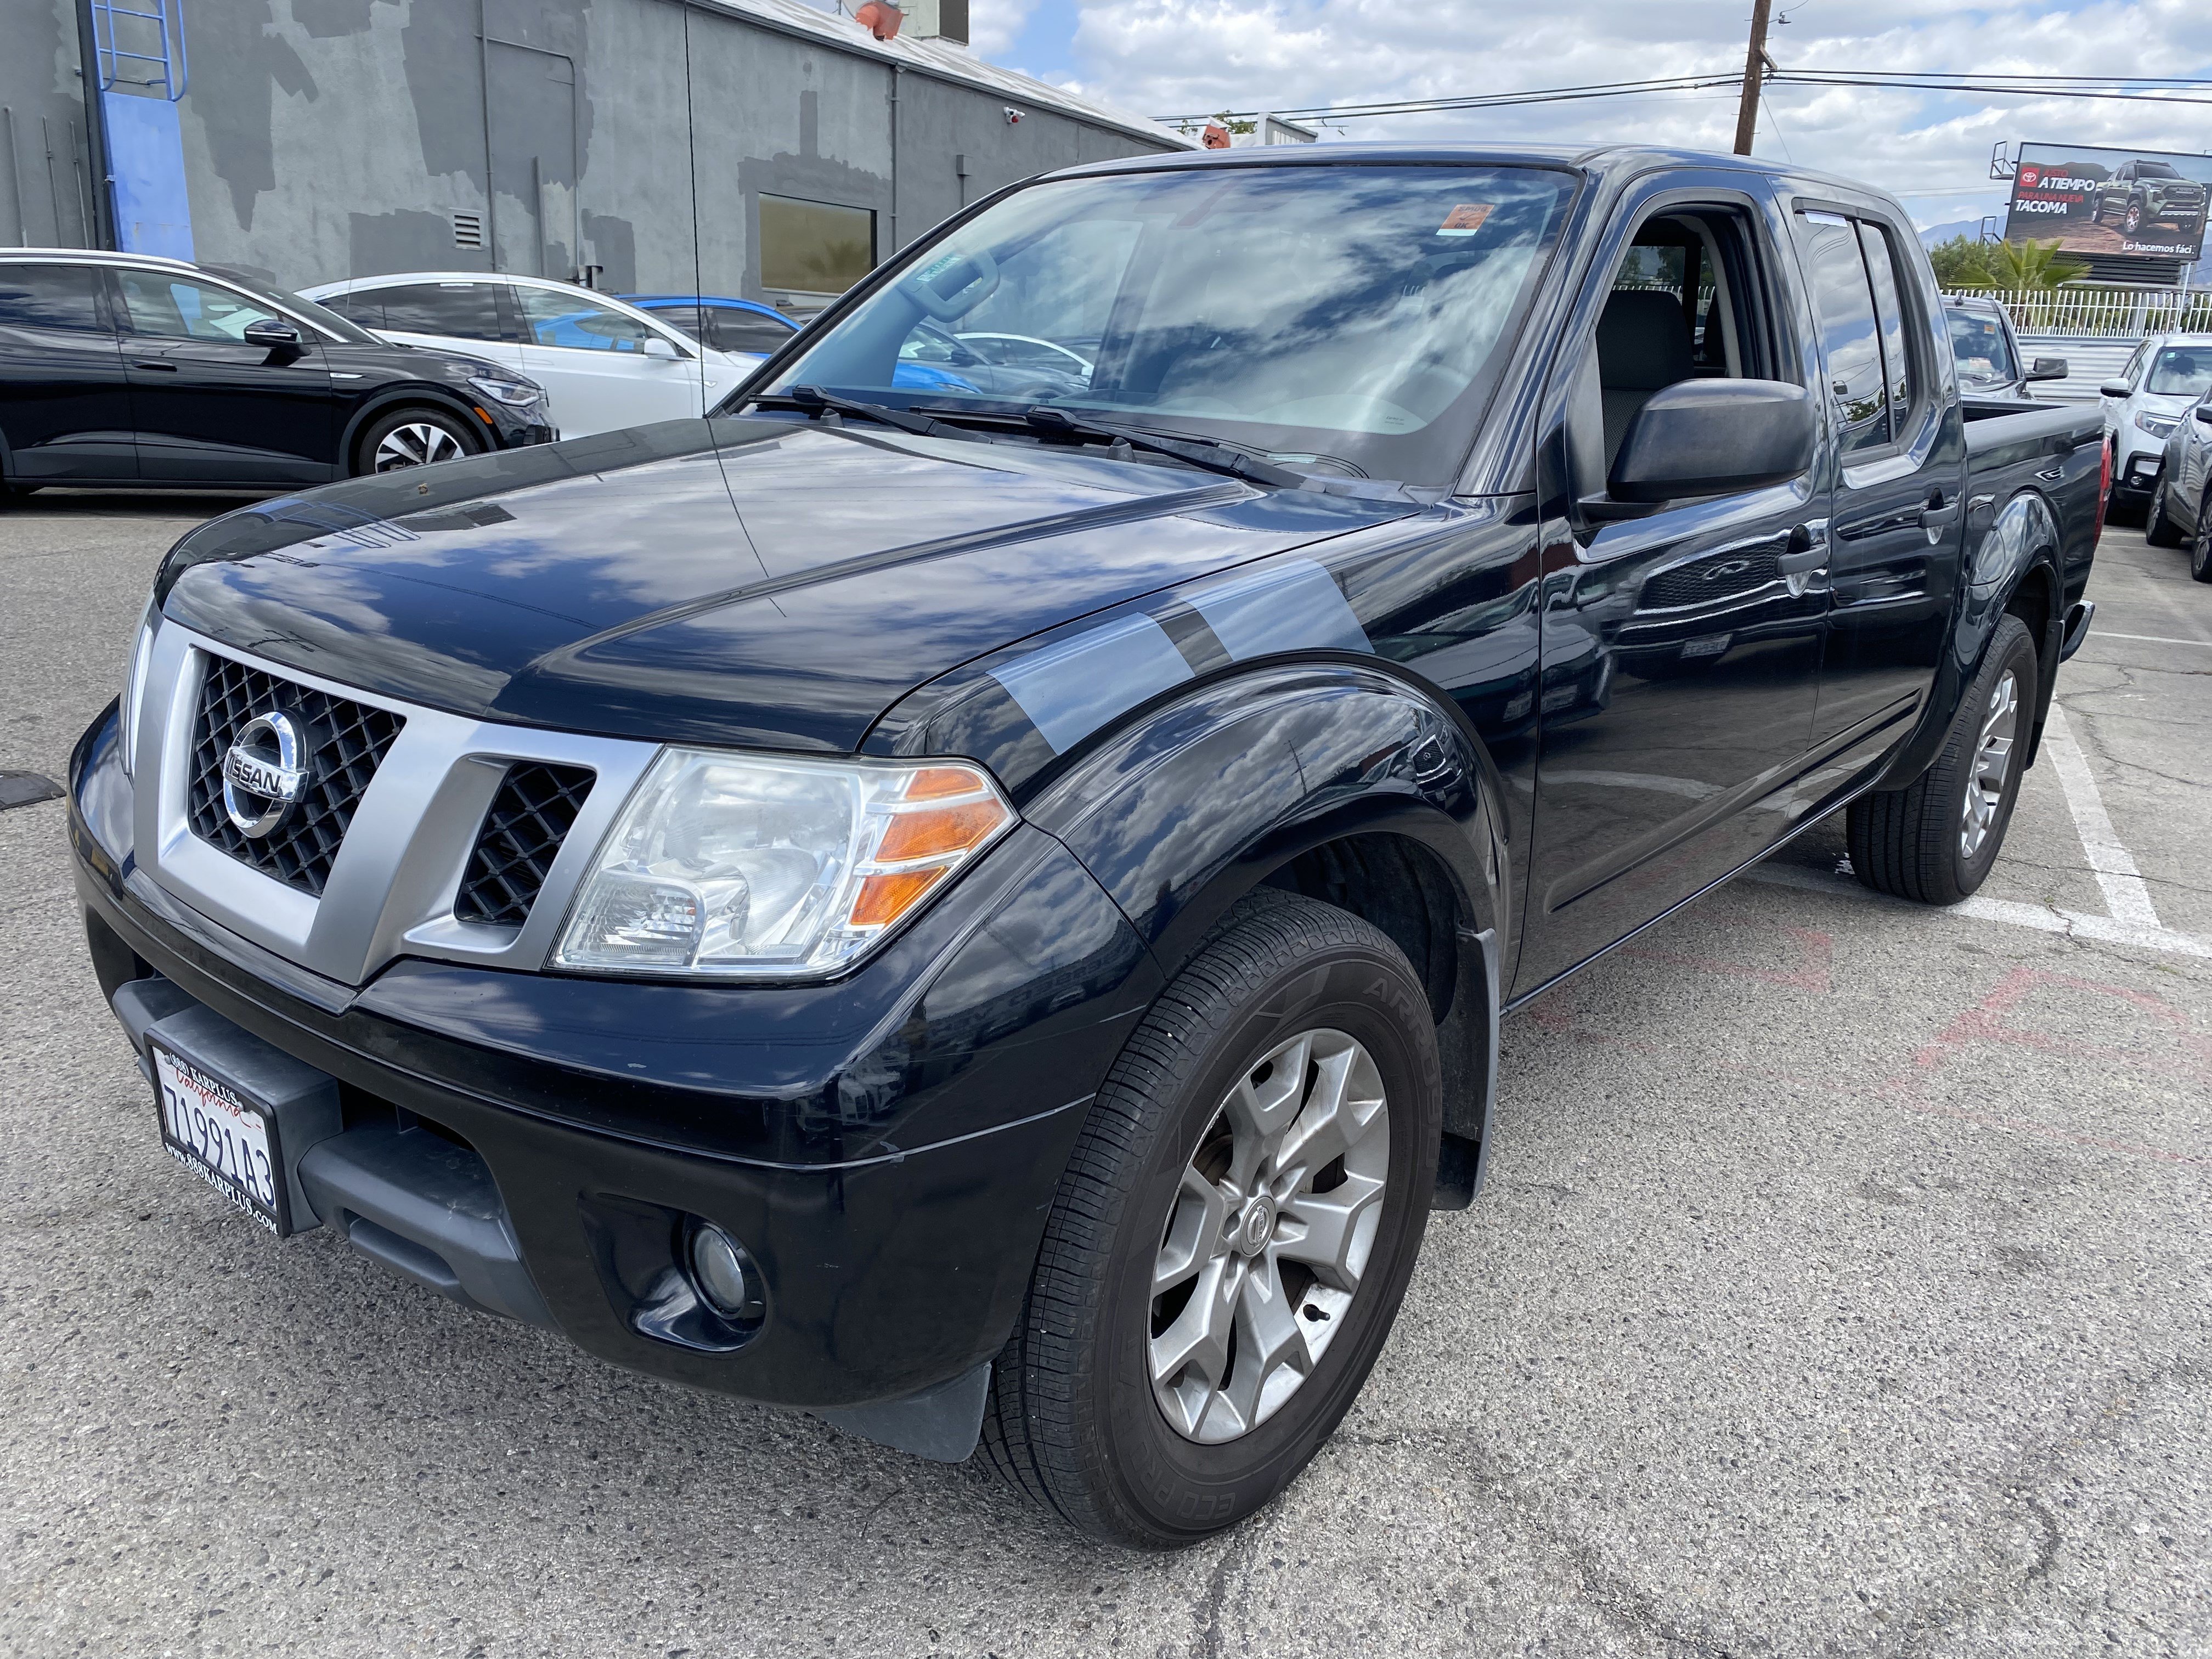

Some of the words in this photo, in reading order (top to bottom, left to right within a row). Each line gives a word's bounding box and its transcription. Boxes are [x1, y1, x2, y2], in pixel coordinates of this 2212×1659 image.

[2050, 177, 2096, 191] TIEMPO
[2018, 191, 2040, 200] PARA
[2040, 193, 2057, 201] UNA
[2058, 194, 2084, 202] NUEVA
[2016, 200, 2068, 214] TACOMA
[2123, 241, 2134, 250] Lo
[2135, 241, 2174, 252] hacemos
[226, 755, 281, 793] NISSAN
[170, 1052, 189, 1076] (888)
[191, 1067, 238, 1106] KARPLUS
[164, 1084, 275, 1207] 71991A3
